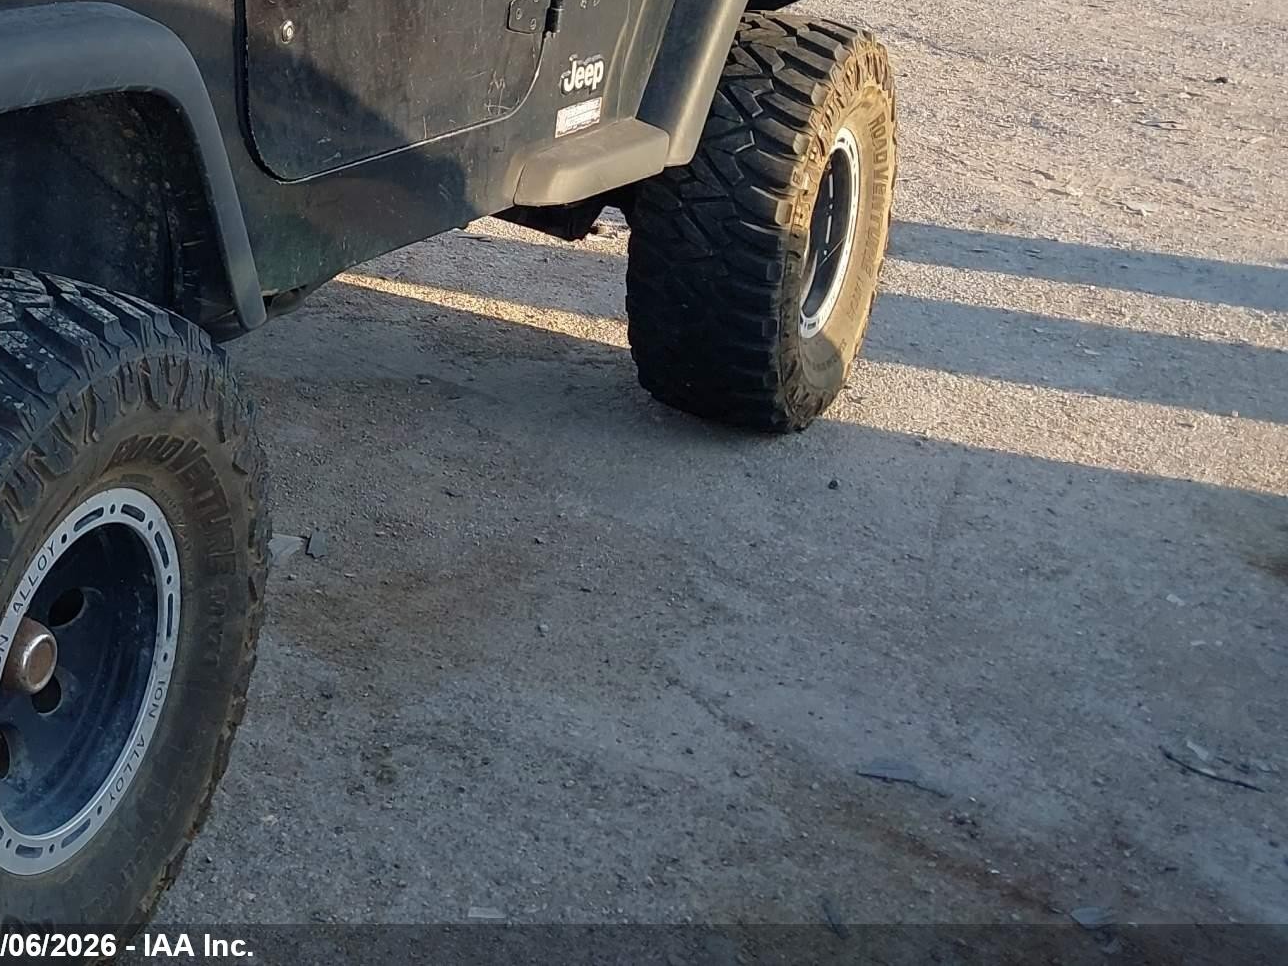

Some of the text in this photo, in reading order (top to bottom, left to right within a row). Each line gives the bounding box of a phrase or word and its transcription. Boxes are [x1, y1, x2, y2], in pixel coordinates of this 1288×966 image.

[562, 58, 605, 93] Jeep
[13, 541, 55, 615] ALLOY
[109, 680, 166, 805] ION ALLOY
